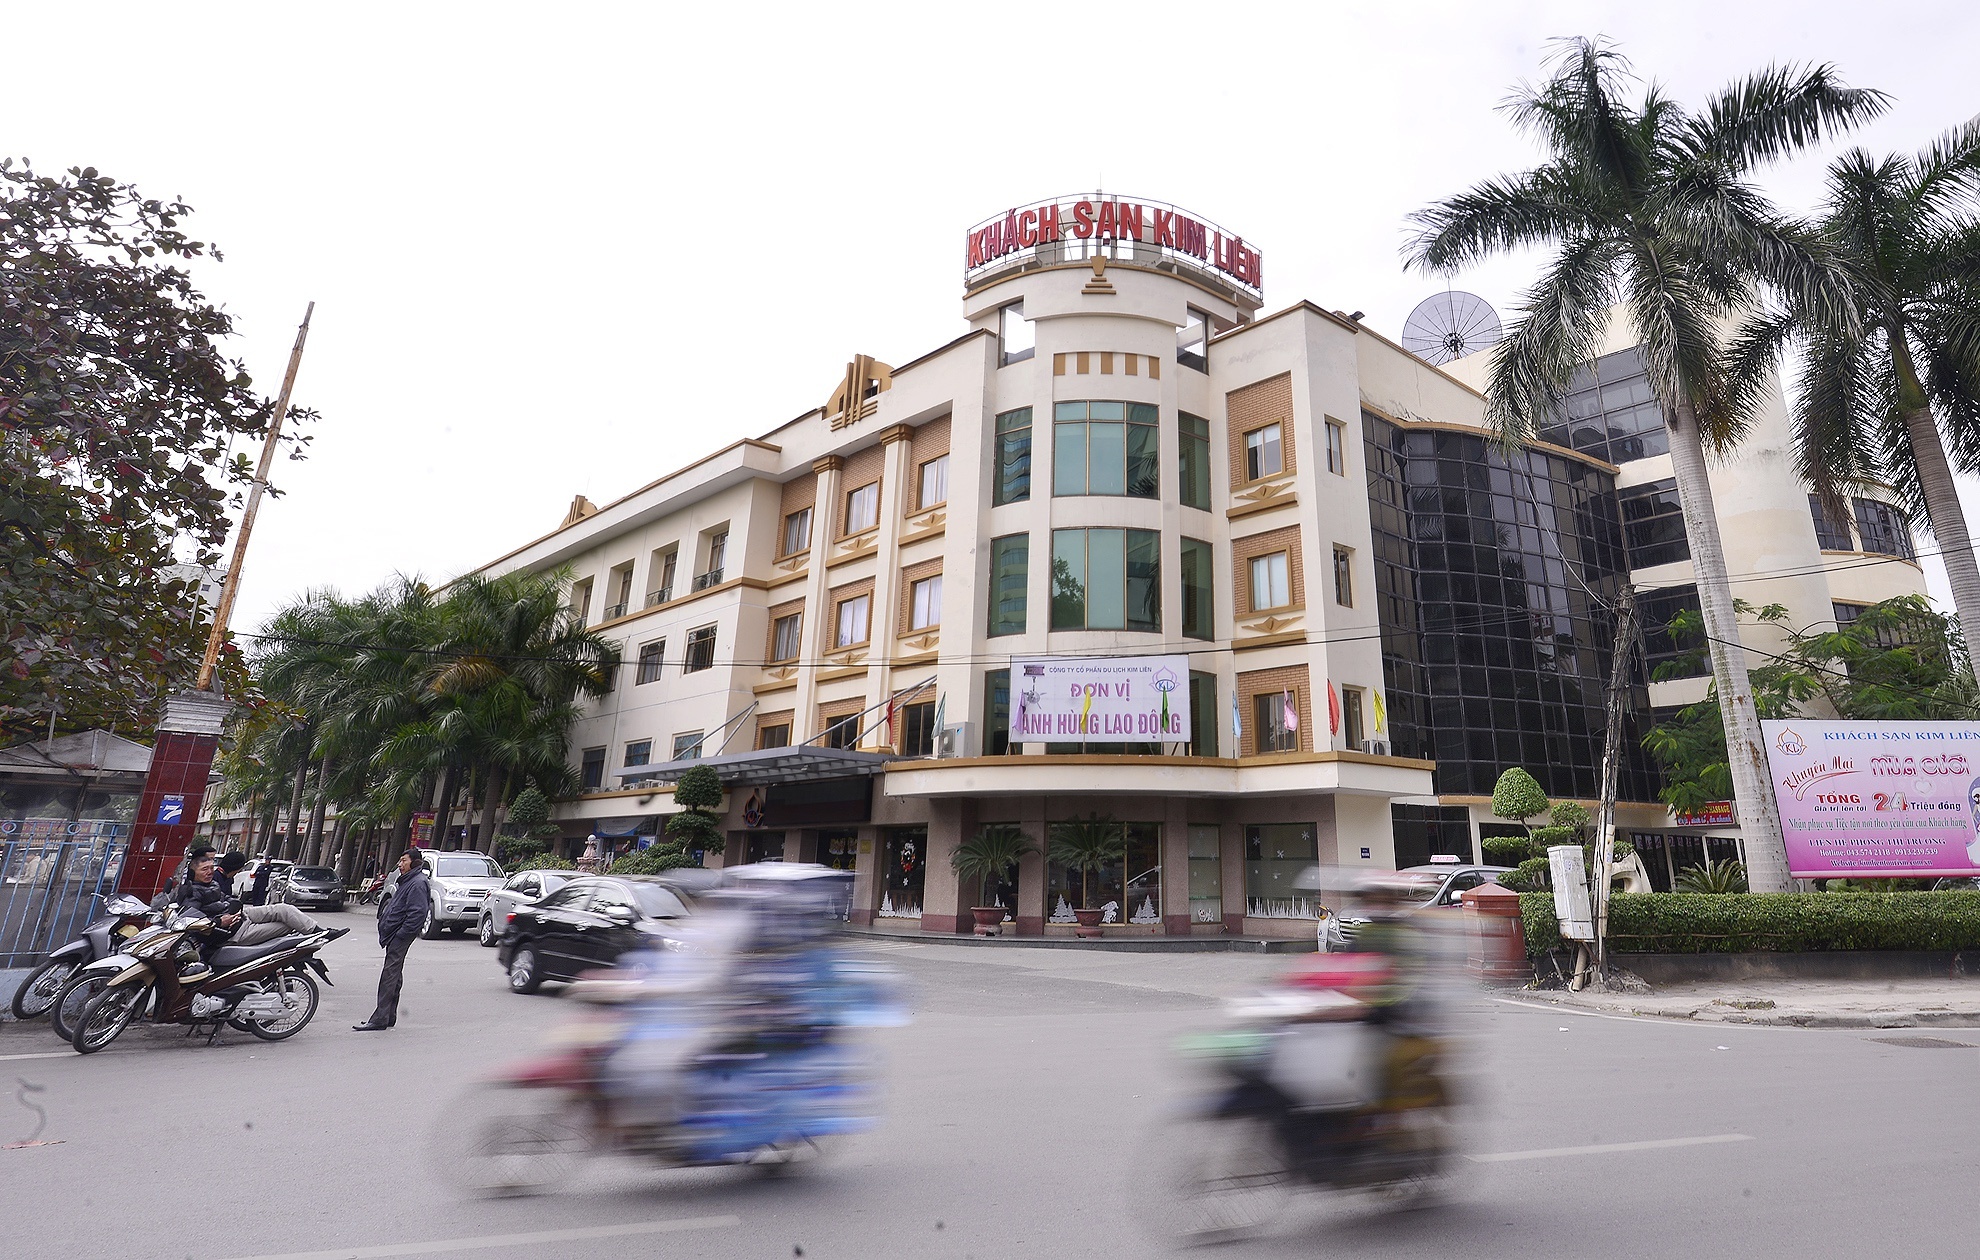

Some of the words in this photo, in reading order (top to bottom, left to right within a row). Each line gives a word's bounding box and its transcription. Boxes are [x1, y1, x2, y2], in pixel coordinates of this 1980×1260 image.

[968, 204, 1059, 268] KHÁCH
[1073, 201, 1143, 245] SẠN
[1154, 208, 1207, 260] KIM
[1213, 231, 1261, 289] LIÊN
[1113, 666, 1126, 675] LỊCH
[1139, 665, 1153, 673] LIÊN
[1071, 683, 1109, 698] ĐƠN
[1022, 713, 1052, 735] ANH
[1104, 713, 1133, 735] LAO
[1824, 730, 1878, 740] KHÁCH
[1882, 732, 1911, 741] SẠN
[1915, 732, 1945, 740] KIM
[1873, 792, 1909, 812] 24
[1911, 801, 1935, 811] Triệu
